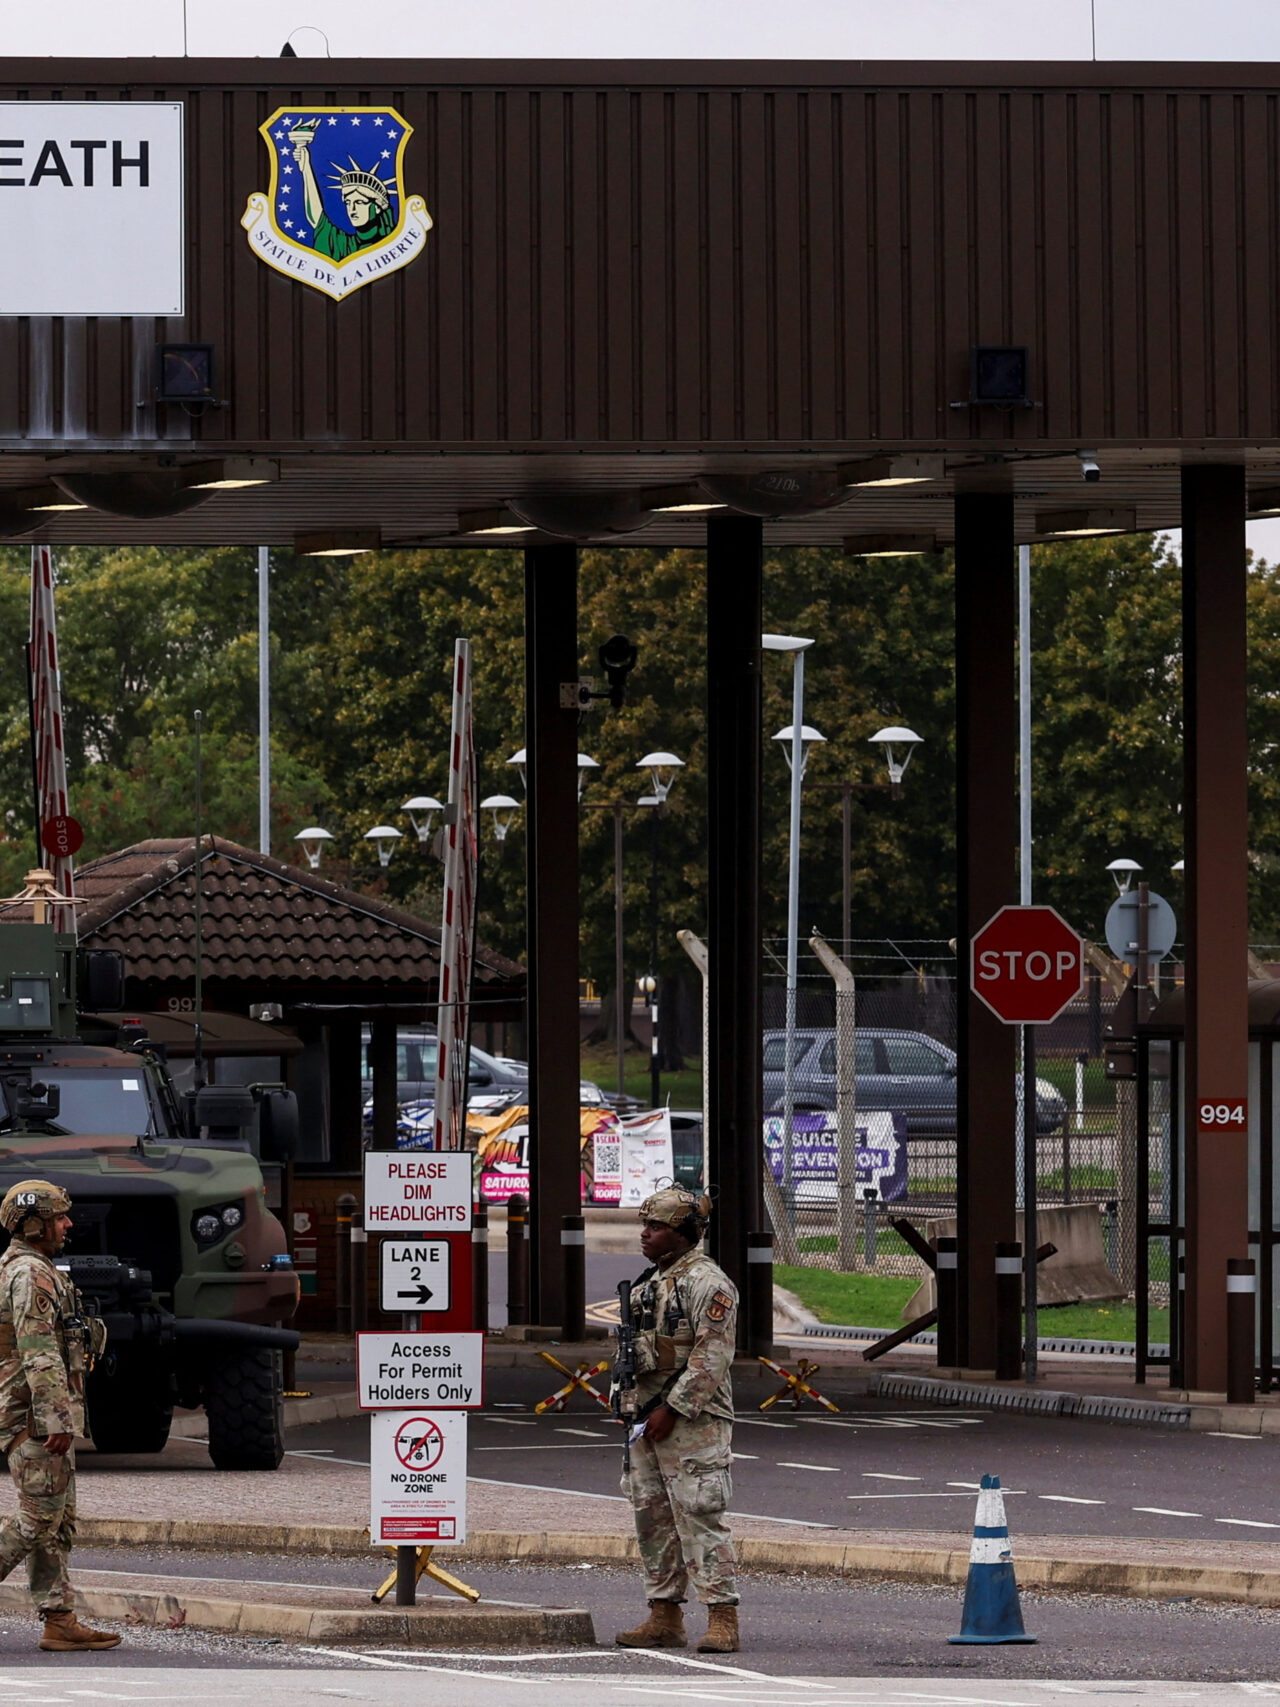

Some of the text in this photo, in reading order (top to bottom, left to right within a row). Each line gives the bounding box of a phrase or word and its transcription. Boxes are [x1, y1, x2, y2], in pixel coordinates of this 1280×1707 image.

[255, 227, 421, 287] STATUE DE LA LIBERTE
[56, 820, 69, 853] STOP
[979, 951, 1076, 981] STOP
[1200, 1104, 1245, 1124] 994
[388, 1163, 447, 1179] PLEASE
[484, 1176, 529, 1189] SATURD
[17, 1193, 36, 1206] K9
[404, 1184, 432, 1200] DIM
[369, 1205, 466, 1222] HEADLIGHTS
[391, 1247, 440, 1263] LANE
[410, 1266, 421, 1281] 2
[391, 1342, 451, 1358] Access
[379, 1363, 463, 1379] For Permit
[369, 1384, 473, 1403] Holders Only
[390, 1473, 447, 1483] NO DRONE
[404, 1484, 434, 1493] ZONE
